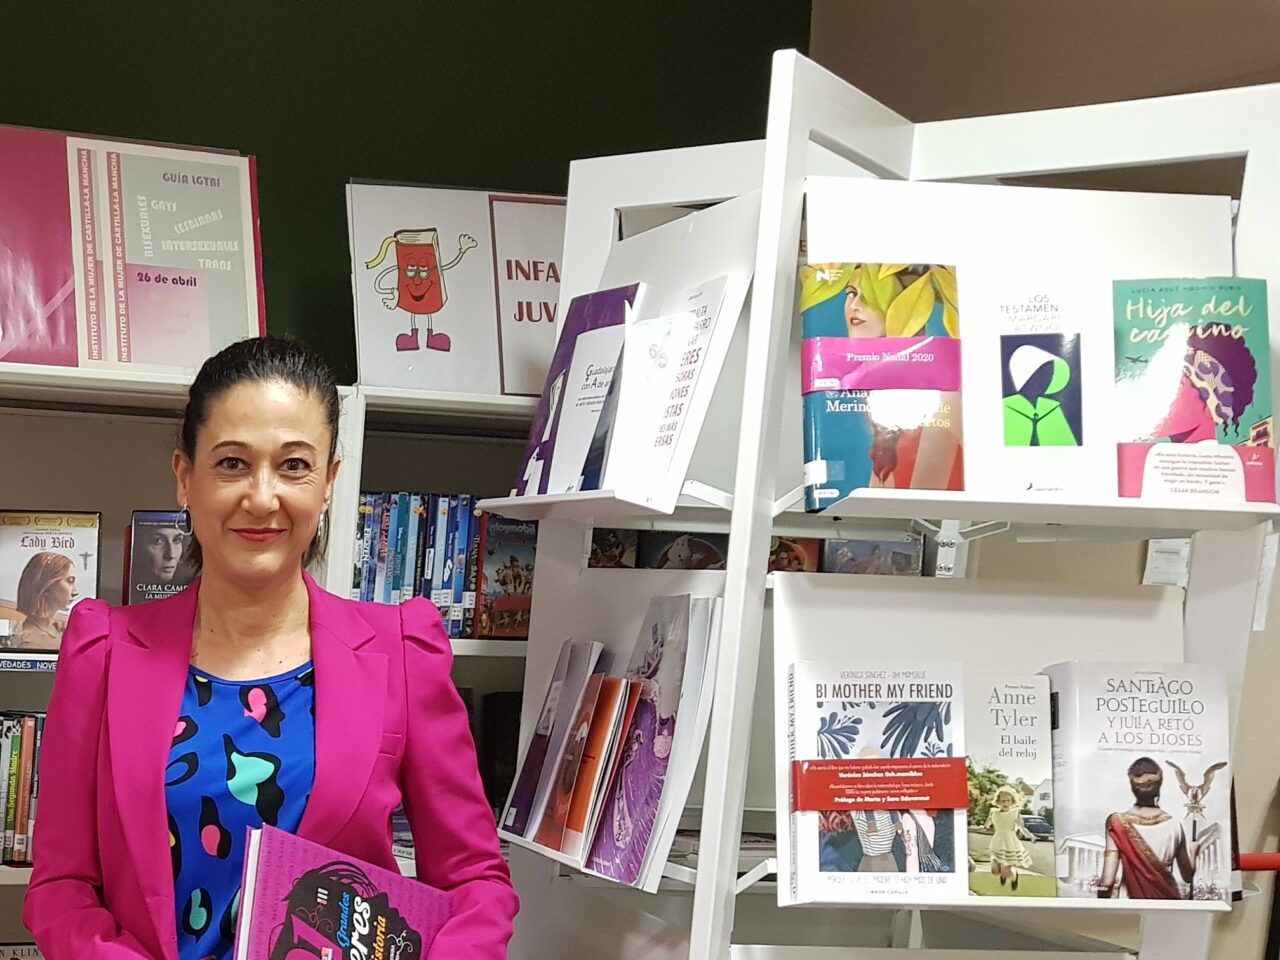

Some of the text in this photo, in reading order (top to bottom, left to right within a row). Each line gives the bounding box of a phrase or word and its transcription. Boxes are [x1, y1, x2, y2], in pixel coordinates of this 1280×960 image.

[192, 176, 220, 187] LGTBI
[199, 258, 231, 271] TRANS
[137, 272, 196, 287] 26 de abril
[514, 301, 557, 322] JUV
[1126, 296, 1253, 322] Hija del
[20, 536, 75, 550] Lady Bird
[816, 684, 953, 698] BI MOTHER MY FRIEND
[1107, 676, 1193, 694] SANTIAGO
[989, 687, 1036, 705] Anne
[1097, 698, 1204, 715] POSTEGUILLO
[991, 709, 1037, 731] Tyler
[1107, 716, 1194, 731] Y JULIA RETÓ
[1001, 735, 1036, 745] El baile
[1098, 733, 1202, 746] A LOS DIOSES
[999, 747, 1036, 759] del reloj
[337, 892, 350, 948] Grandes
